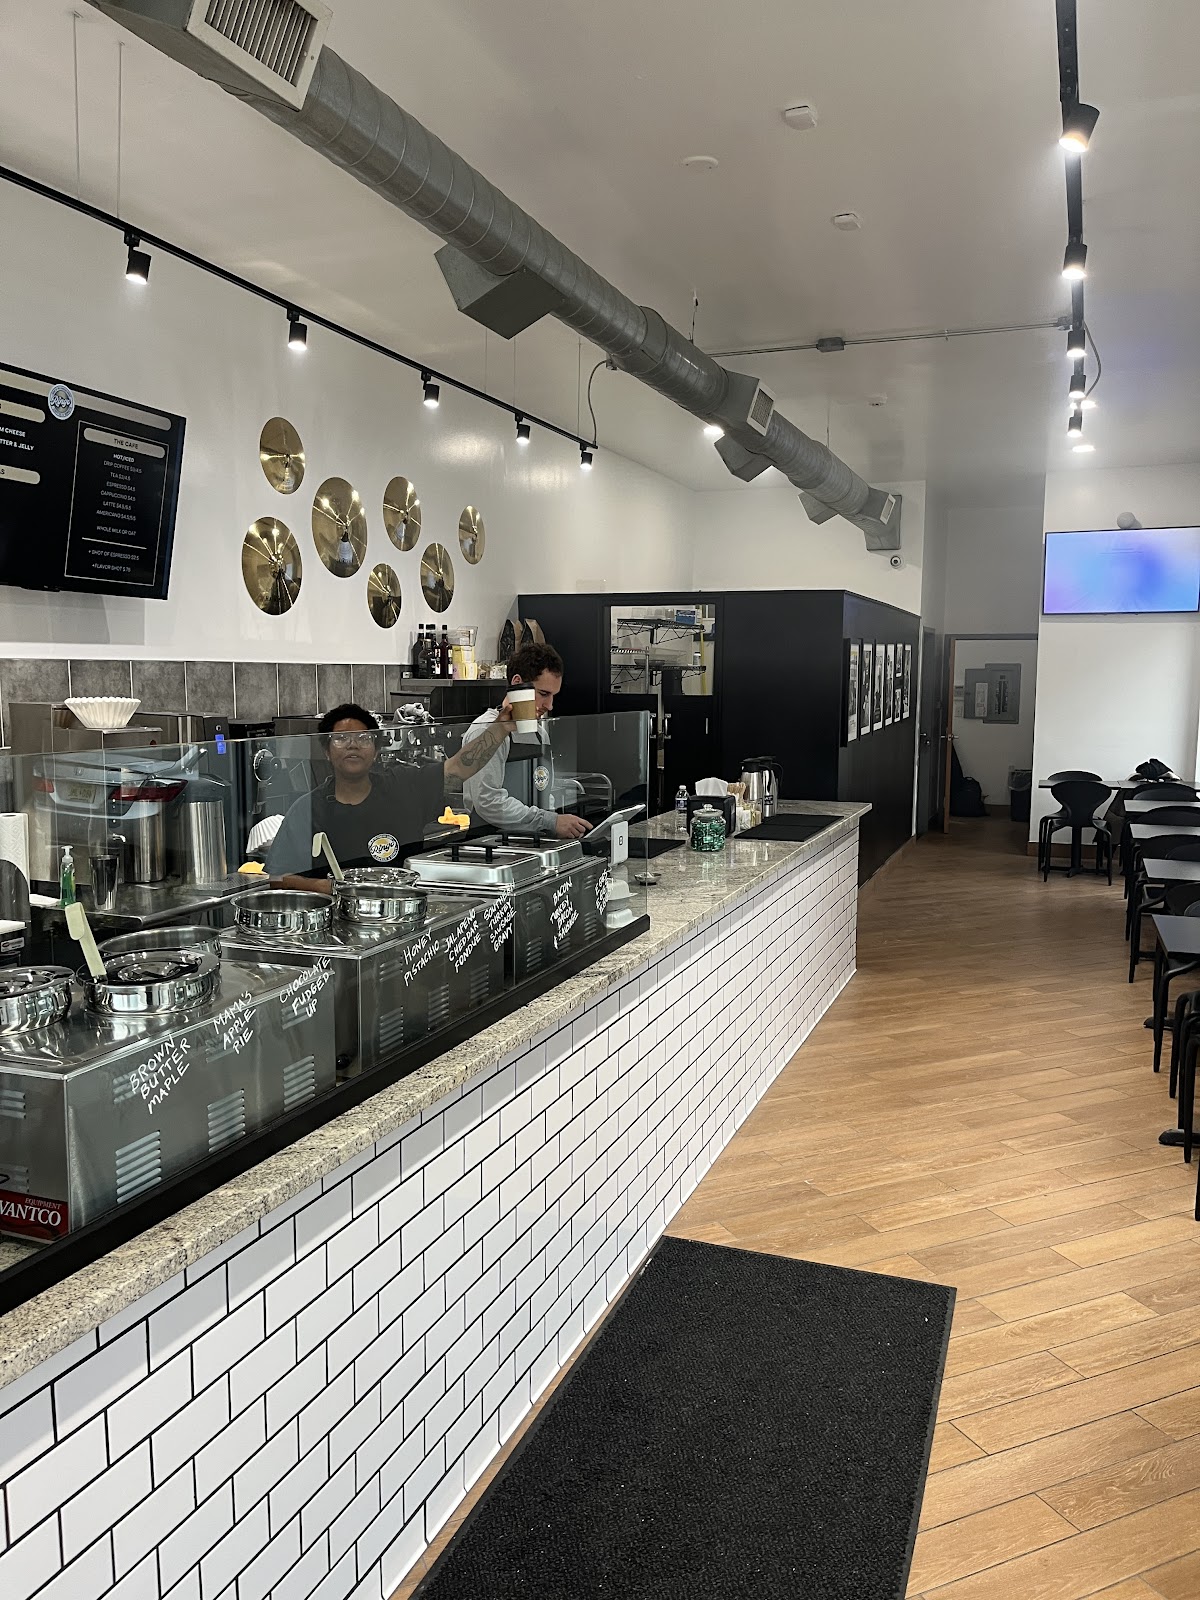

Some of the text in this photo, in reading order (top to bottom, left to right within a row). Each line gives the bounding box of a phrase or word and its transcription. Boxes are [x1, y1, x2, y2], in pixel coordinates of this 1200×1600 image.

[6, 428, 26, 437] CHEESE
[113, 438, 124, 446] THE
[113, 454, 134, 462] HOT/ICED
[113, 462, 130, 471] COFFEE
[106, 481, 128, 490] ESPRESSO
[96, 509, 120, 518] AMERICANO
[96, 525, 111, 533] WHOLE
[110, 552, 131, 560] ESPRESSO
[553, 876, 573, 907] BACON
[489, 898, 512, 930] TURKEY
[550, 894, 570, 924] TURKEY
[557, 901, 573, 930] BACON
[489, 906, 517, 943] SAUSAGE
[493, 923, 513, 952] GRAVY
[403, 927, 432, 965] HONEY
[448, 920, 479, 961] CHEDDAR
[454, 932, 481, 973] FONDUE
[403, 940, 440, 986] PISTACHIO
[279, 956, 331, 1004] CHOCOLATE
[291, 971, 330, 1016] FUDGED
[305, 998, 318, 1018] UP
[222, 1008, 257, 1050] APPLE
[232, 1028, 254, 1054] PIE
[129, 1034, 175, 1094] BROWN
[140, 1037, 191, 1100] BUTTER
[147, 1063, 190, 1114] MAPLE
[25, 1197, 62, 1210] EQUIPMENT
